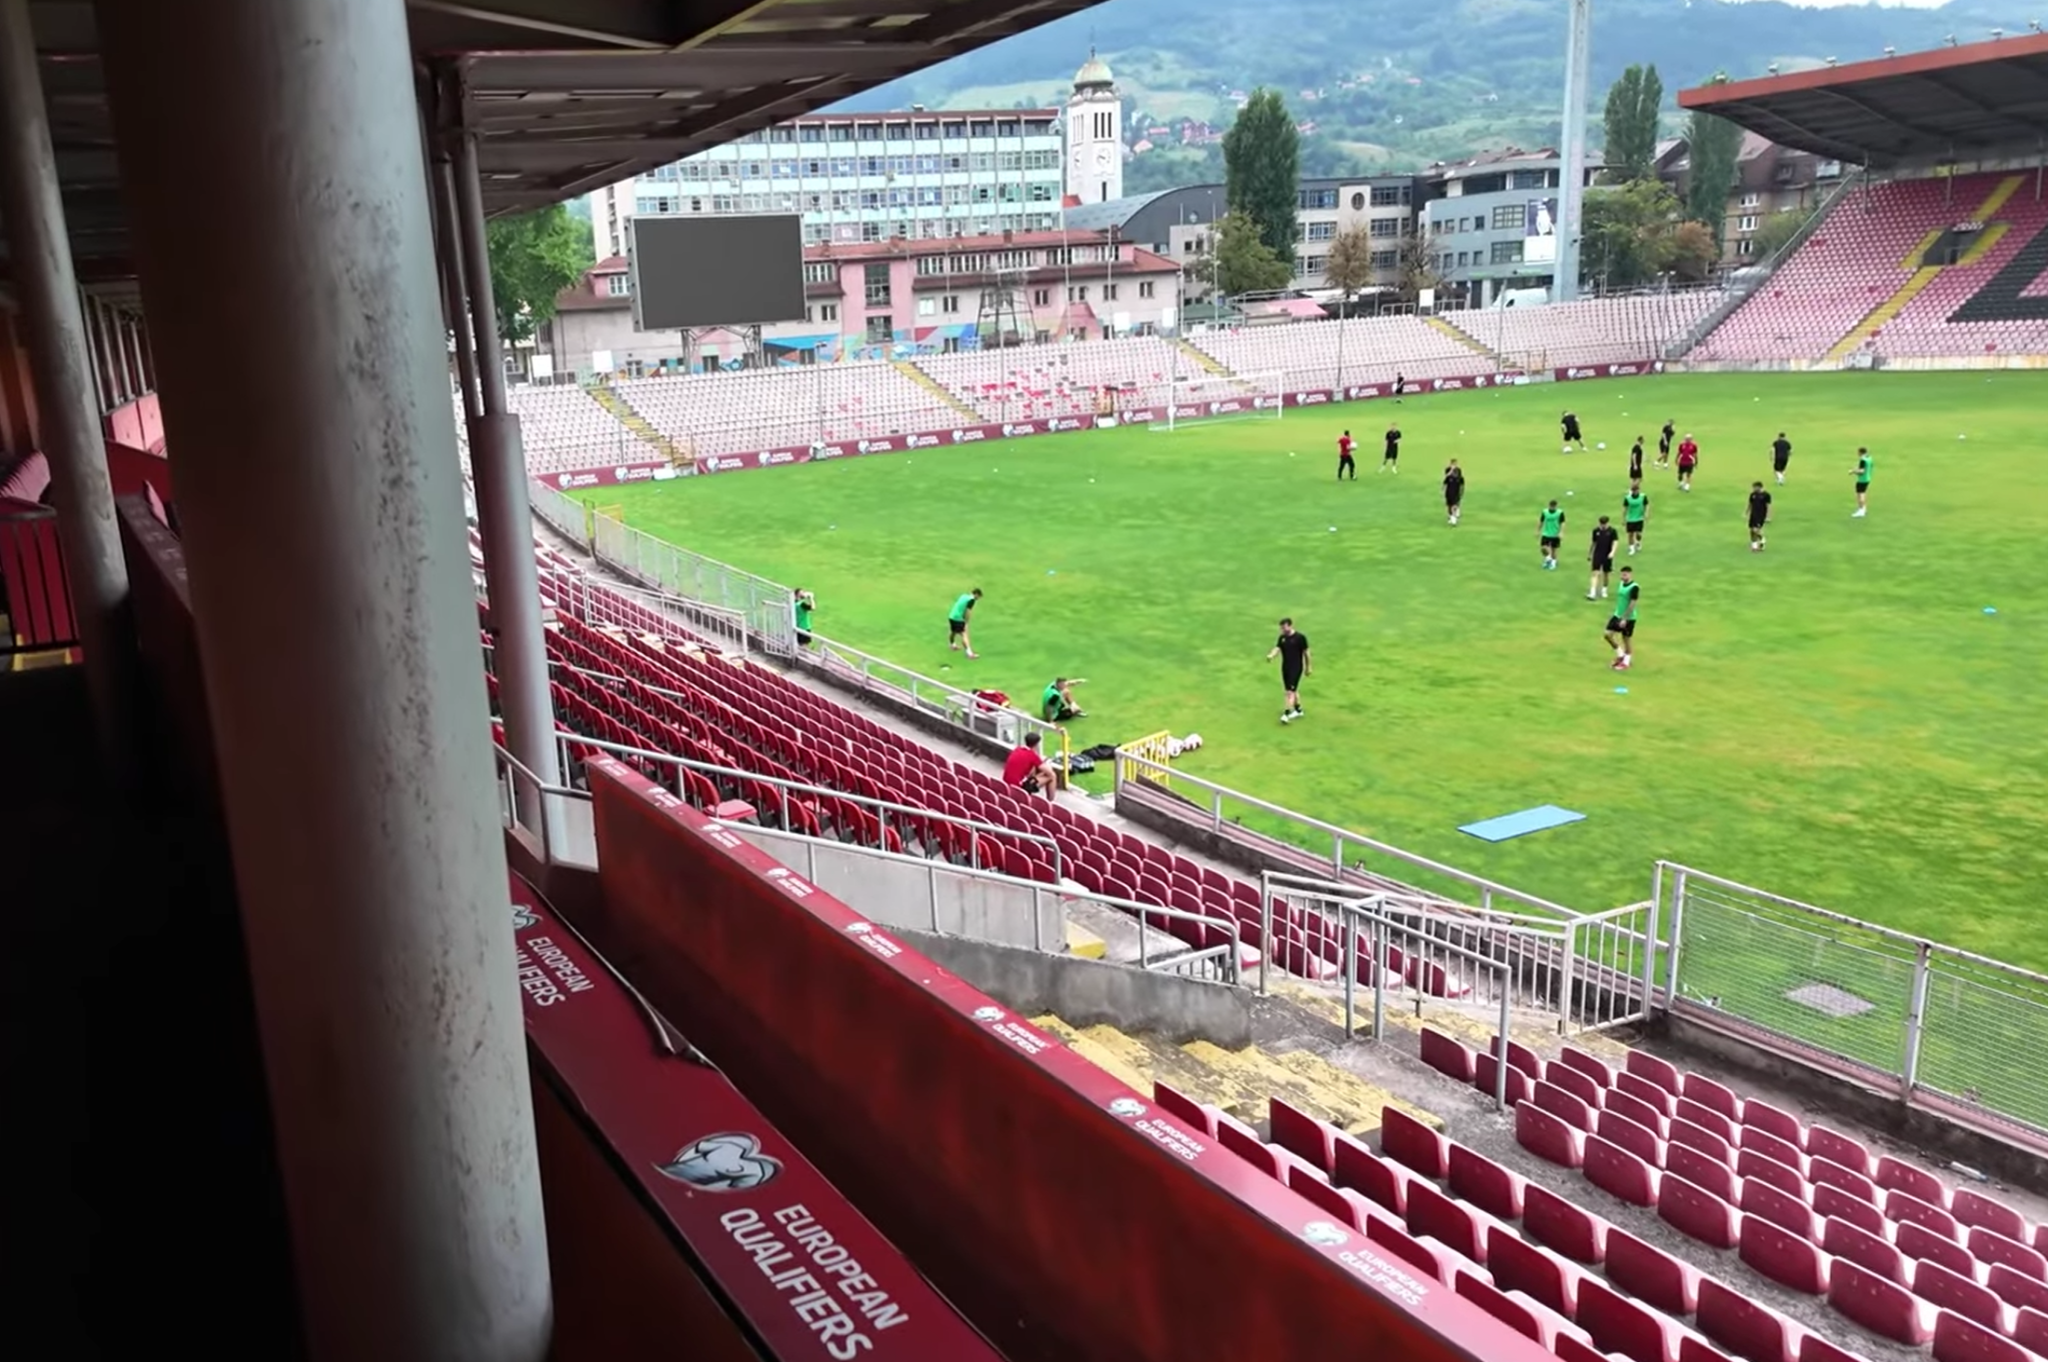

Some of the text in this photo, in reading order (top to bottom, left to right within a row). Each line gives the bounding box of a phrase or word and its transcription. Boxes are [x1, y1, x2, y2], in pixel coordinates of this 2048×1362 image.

[527, 936, 595, 993] EUROPEAN
[1134, 1119, 1199, 1160] QUALIFIERS
[1151, 1118, 1206, 1153] EUROPEAN
[720, 1207, 873, 1361] QUALIFIERS
[773, 1203, 909, 1330] EUROPEAN
[1338, 1250, 1423, 1306] QUALIFIERS
[1357, 1249, 1430, 1295] EUROPEAN
